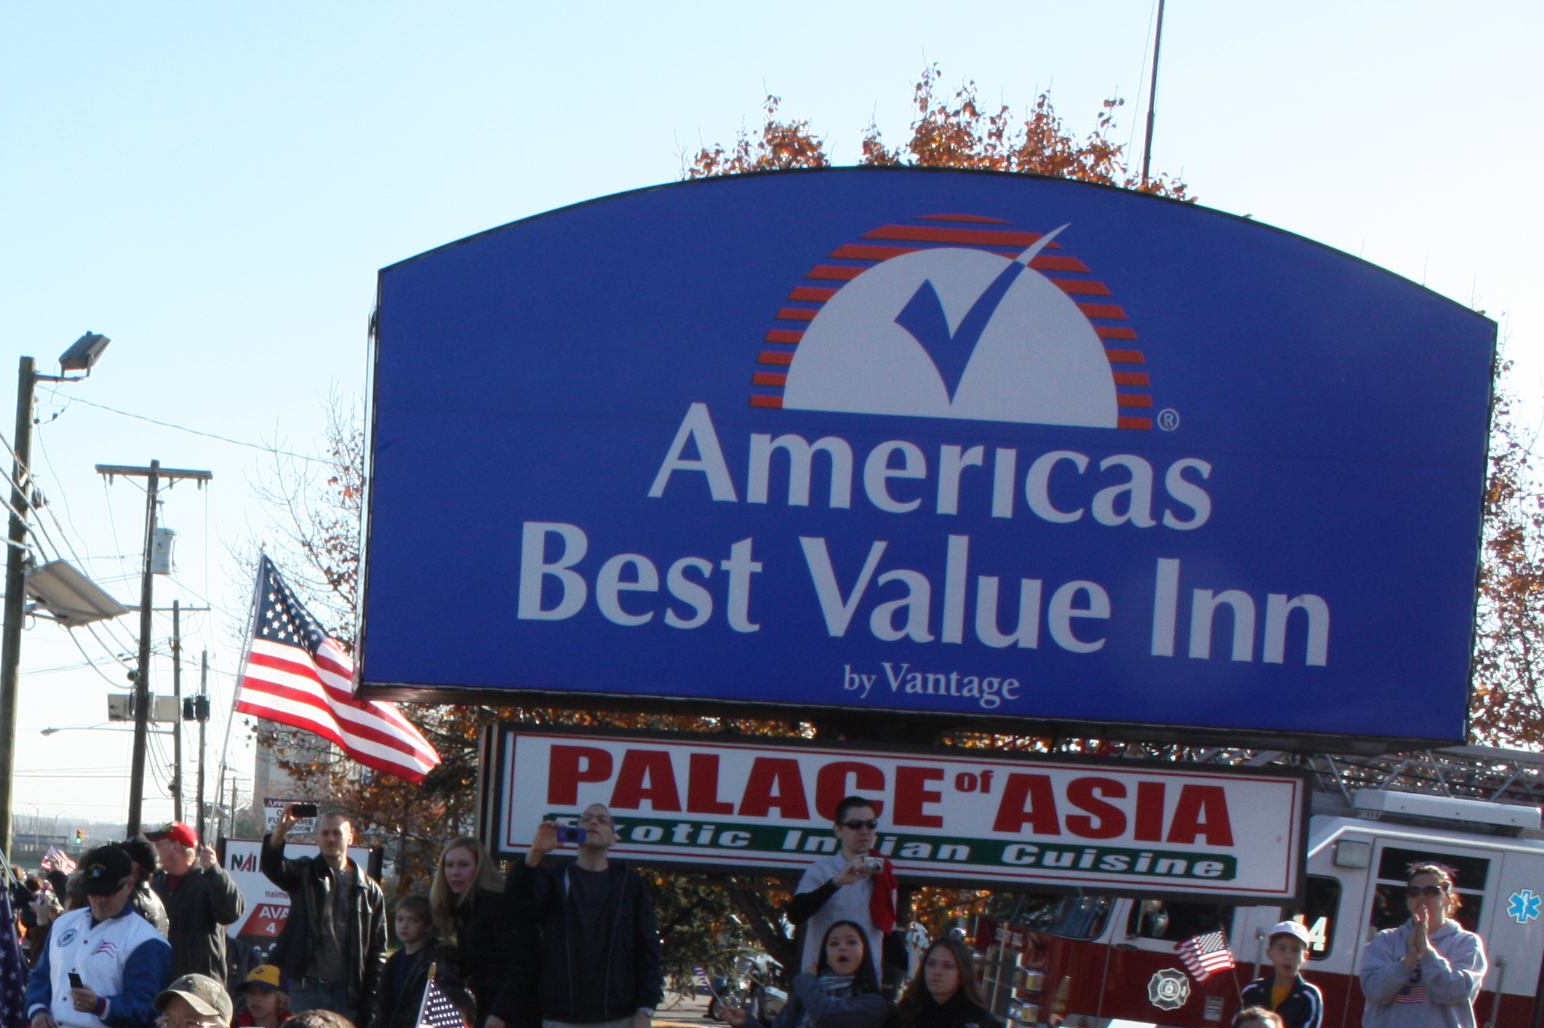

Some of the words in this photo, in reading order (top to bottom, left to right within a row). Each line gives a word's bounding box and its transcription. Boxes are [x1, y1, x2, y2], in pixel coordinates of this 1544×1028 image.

[649, 402, 1213, 531] Americas
[516, 520, 763, 632] Best
[800, 533, 1112, 651] Value
[1153, 557, 1331, 666] Inn
[843, 664, 876, 693] by
[881, 662, 1020, 707] Vantage
[547, 744, 944, 828] PALACE
[954, 769, 994, 794] of
[992, 772, 1235, 847] ASIA
[782, 829, 971, 861] Inian
[1001, 843, 1226, 878] Cuisine
